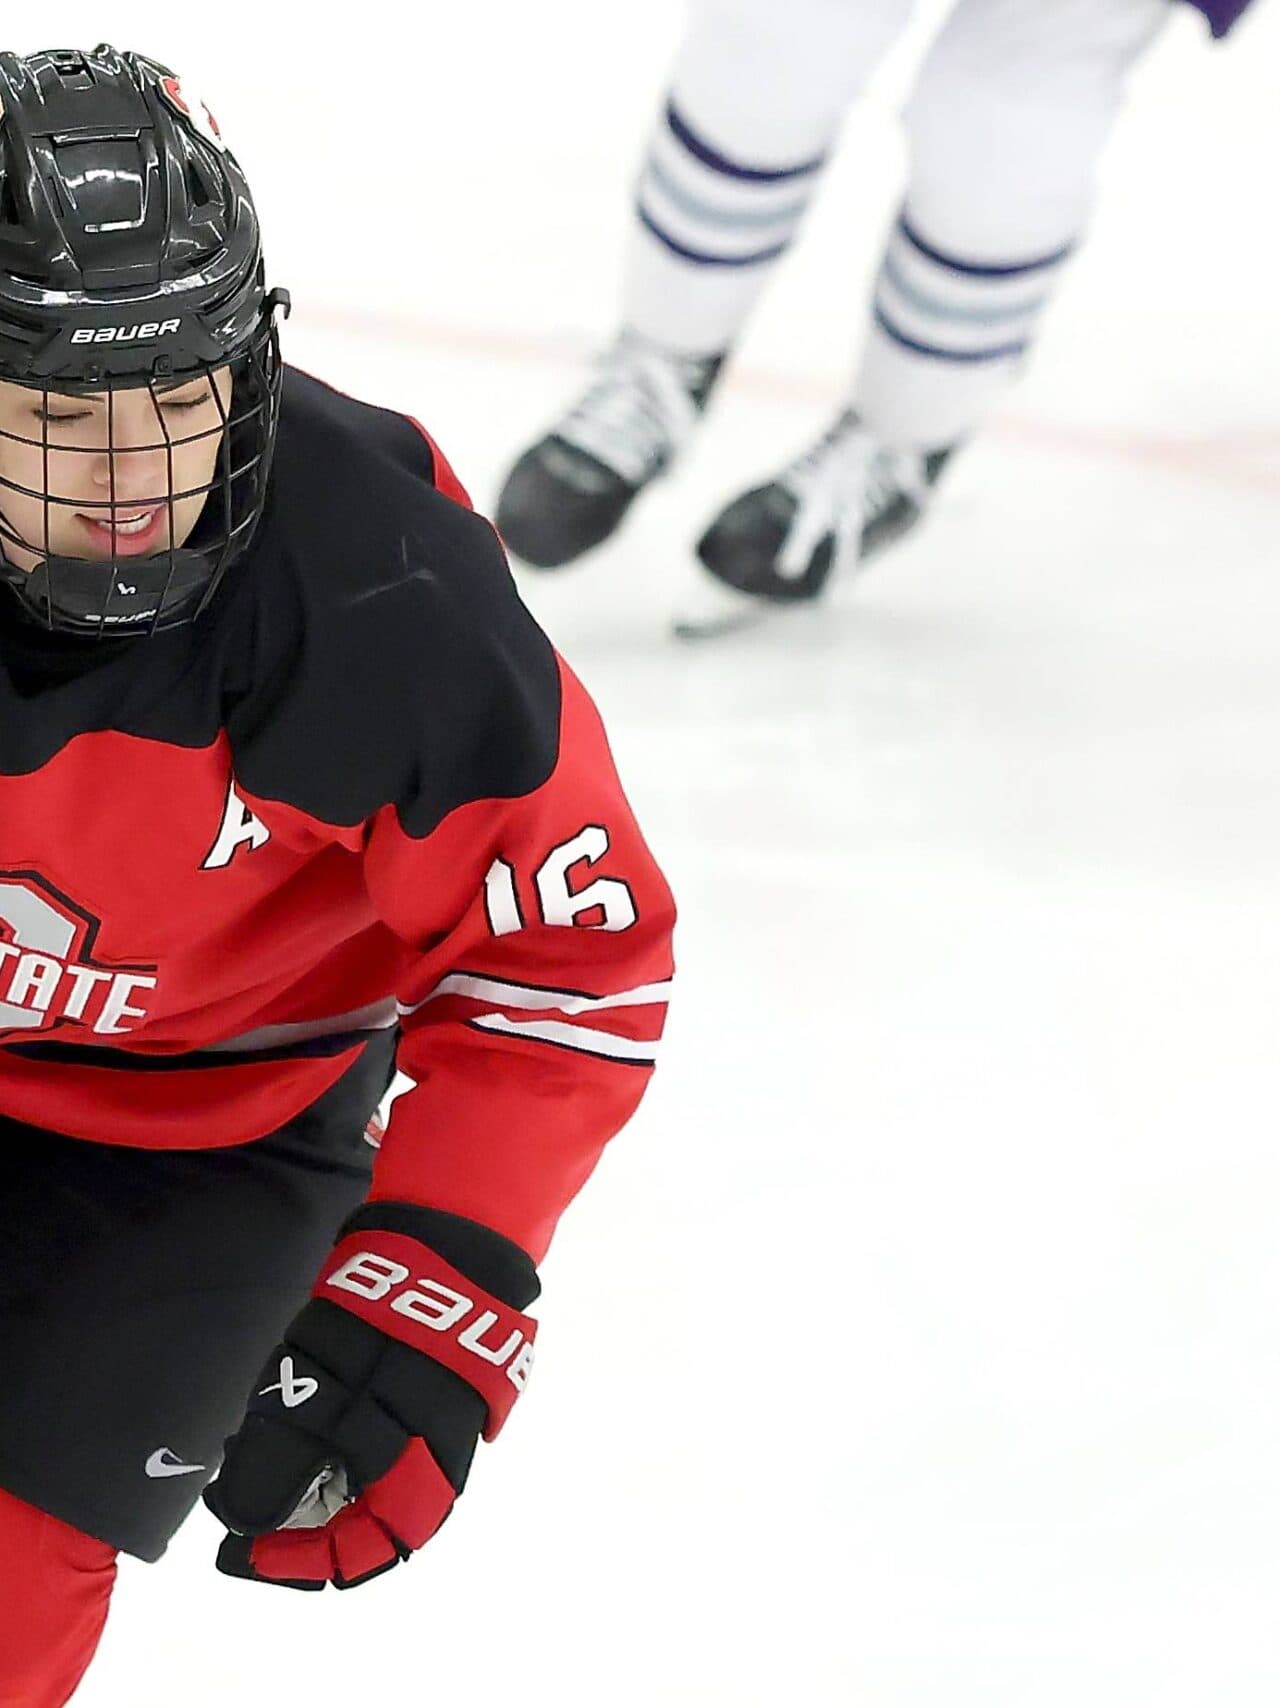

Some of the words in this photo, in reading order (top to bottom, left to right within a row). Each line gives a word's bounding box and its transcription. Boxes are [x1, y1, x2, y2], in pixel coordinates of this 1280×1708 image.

[70, 318, 181, 344] BAUER
[200, 776, 271, 870] A
[483, 824, 639, 937] 16
[325, 1250, 536, 1395] BAUE
